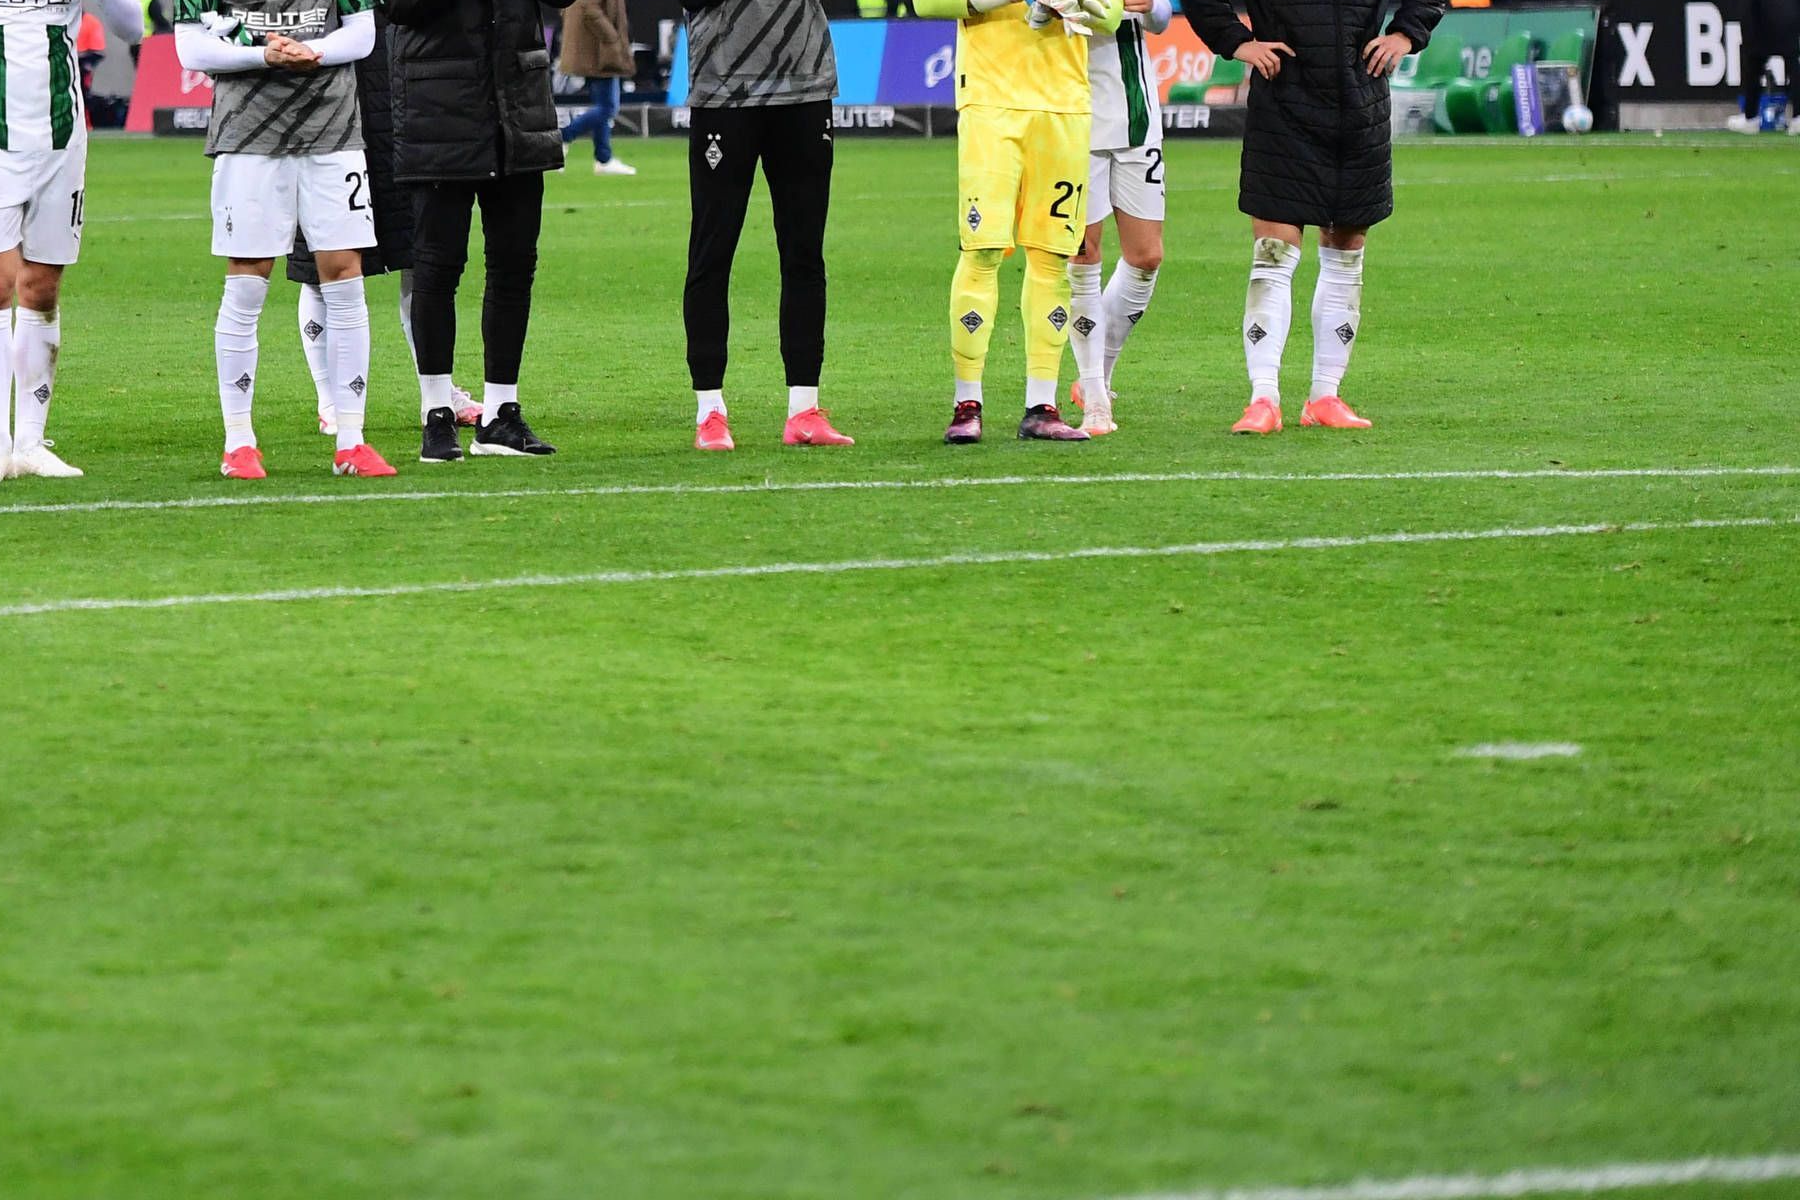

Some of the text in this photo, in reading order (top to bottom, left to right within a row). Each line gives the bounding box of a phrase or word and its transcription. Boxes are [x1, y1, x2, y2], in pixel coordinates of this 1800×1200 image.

[232, 8, 327, 26] REUTER
[832, 105, 896, 128] EUTER
[1161, 105, 1210, 129] TER
[1145, 147, 1163, 185] 2
[1049, 181, 1084, 220] 21
